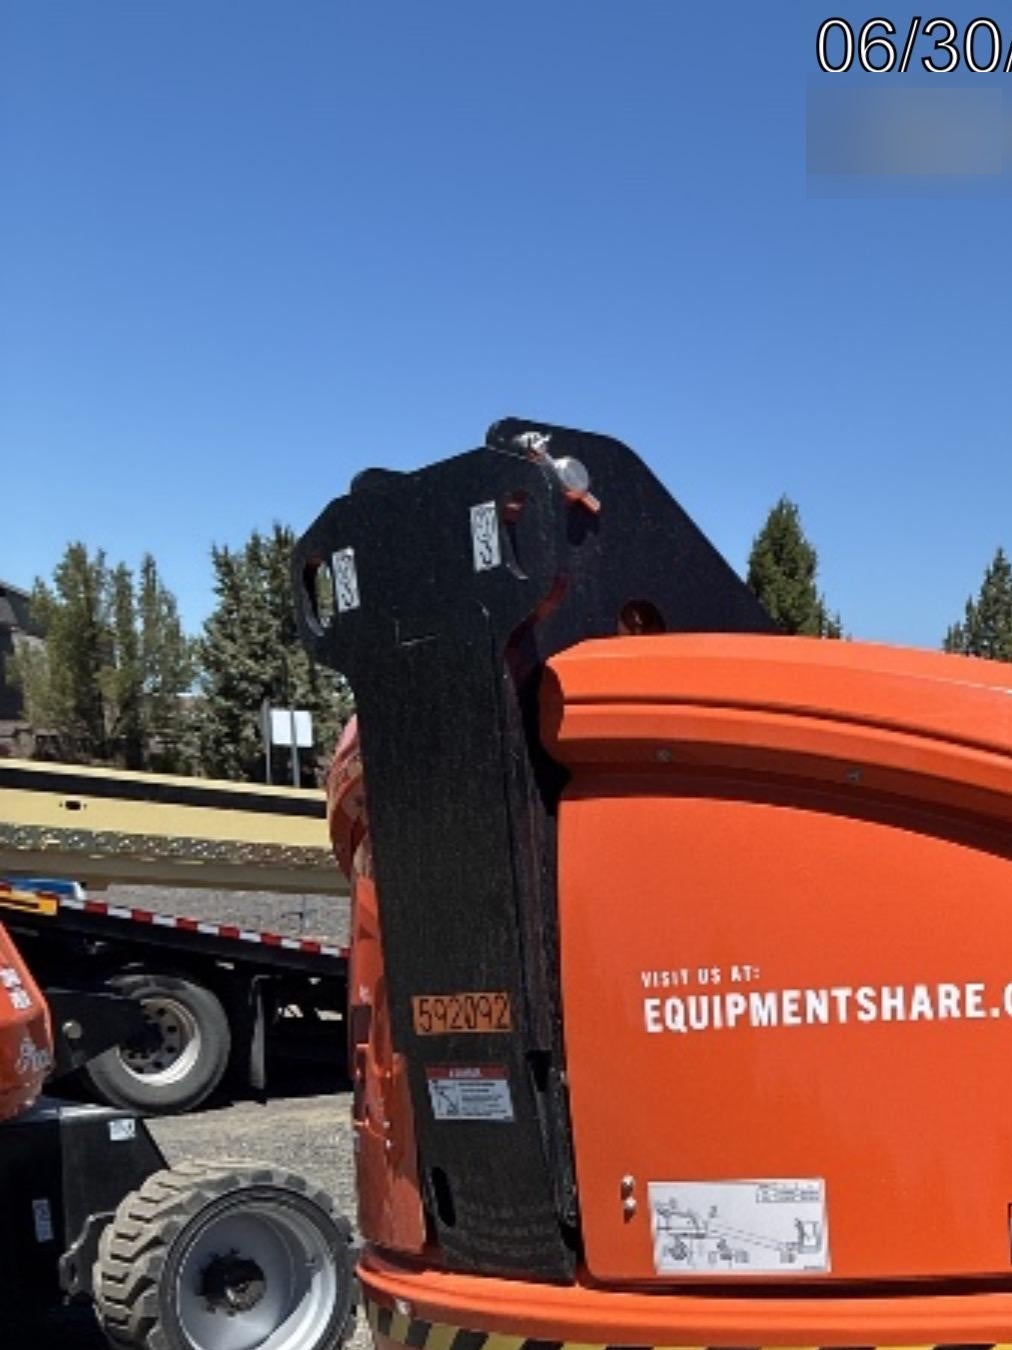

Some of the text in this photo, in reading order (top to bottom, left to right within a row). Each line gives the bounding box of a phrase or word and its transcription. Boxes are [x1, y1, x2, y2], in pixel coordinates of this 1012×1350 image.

[641, 967, 760, 988] VISIT US AT:
[419, 994, 509, 1033] 592092
